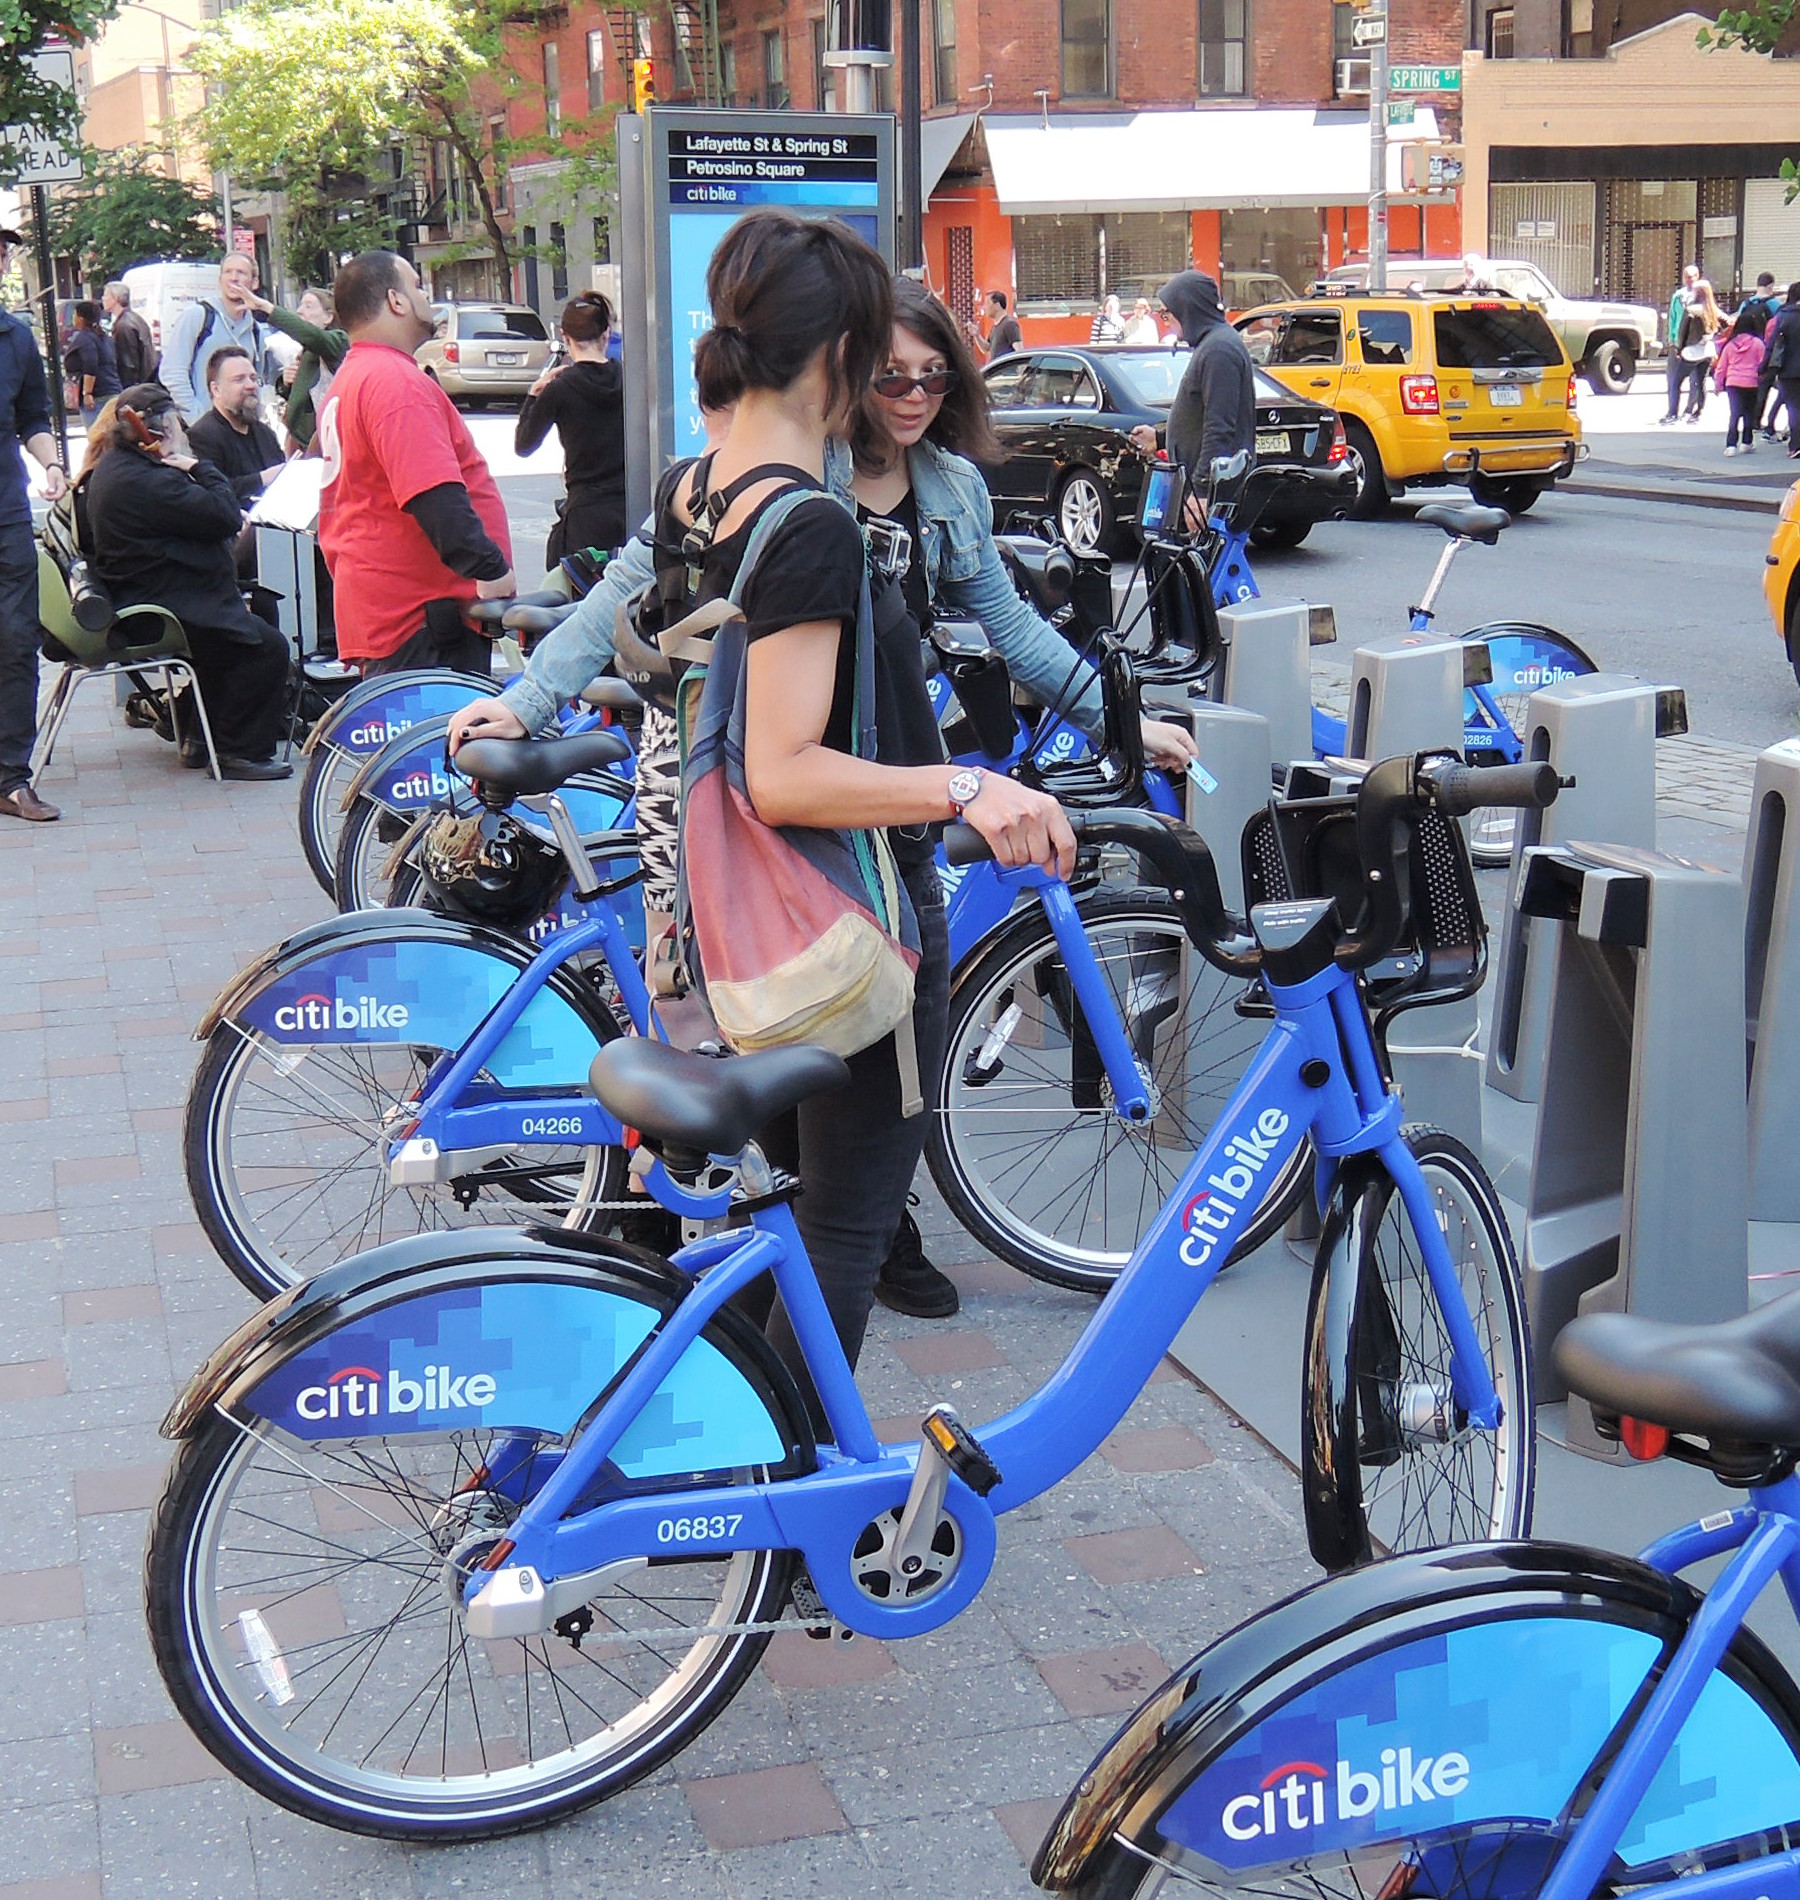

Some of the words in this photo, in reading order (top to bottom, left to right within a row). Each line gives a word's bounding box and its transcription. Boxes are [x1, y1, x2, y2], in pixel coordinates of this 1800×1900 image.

[1393, 70, 1440, 88] SPRING
[1444, 70, 1457, 80] ST
[4, 125, 57, 144] LAN
[686, 135, 751, 154] Lafayette
[753, 137, 770, 152] St
[771, 138, 783, 152] &
[785, 138, 830, 156] Spring
[832, 139, 848, 154] St
[23, 149, 70, 170] EAD
[686, 160, 753, 176] Petrosino
[755, 161, 805, 179] Square
[709, 185, 737, 201] bike
[1513, 665, 1541, 685] citi
[350, 721, 386, 745] citi
[386, 719, 412, 742] bi
[1038, 732, 1075, 766] ke
[391, 773, 430, 799] citi
[528, 914, 558, 941] iti
[275, 995, 331, 1031] citi
[335, 996, 409, 1030] bike
[521, 1116, 583, 1136] 04266
[1207, 1107, 1290, 1200] bike
[1179, 1192, 1237, 1267] citi
[296, 1369, 380, 1420] citi
[388, 1364, 497, 1414] bike
[656, 1513, 744, 1543] 06837
[1221, 1765, 1326, 1841] citi
[1336, 1746, 1471, 1821] bike
